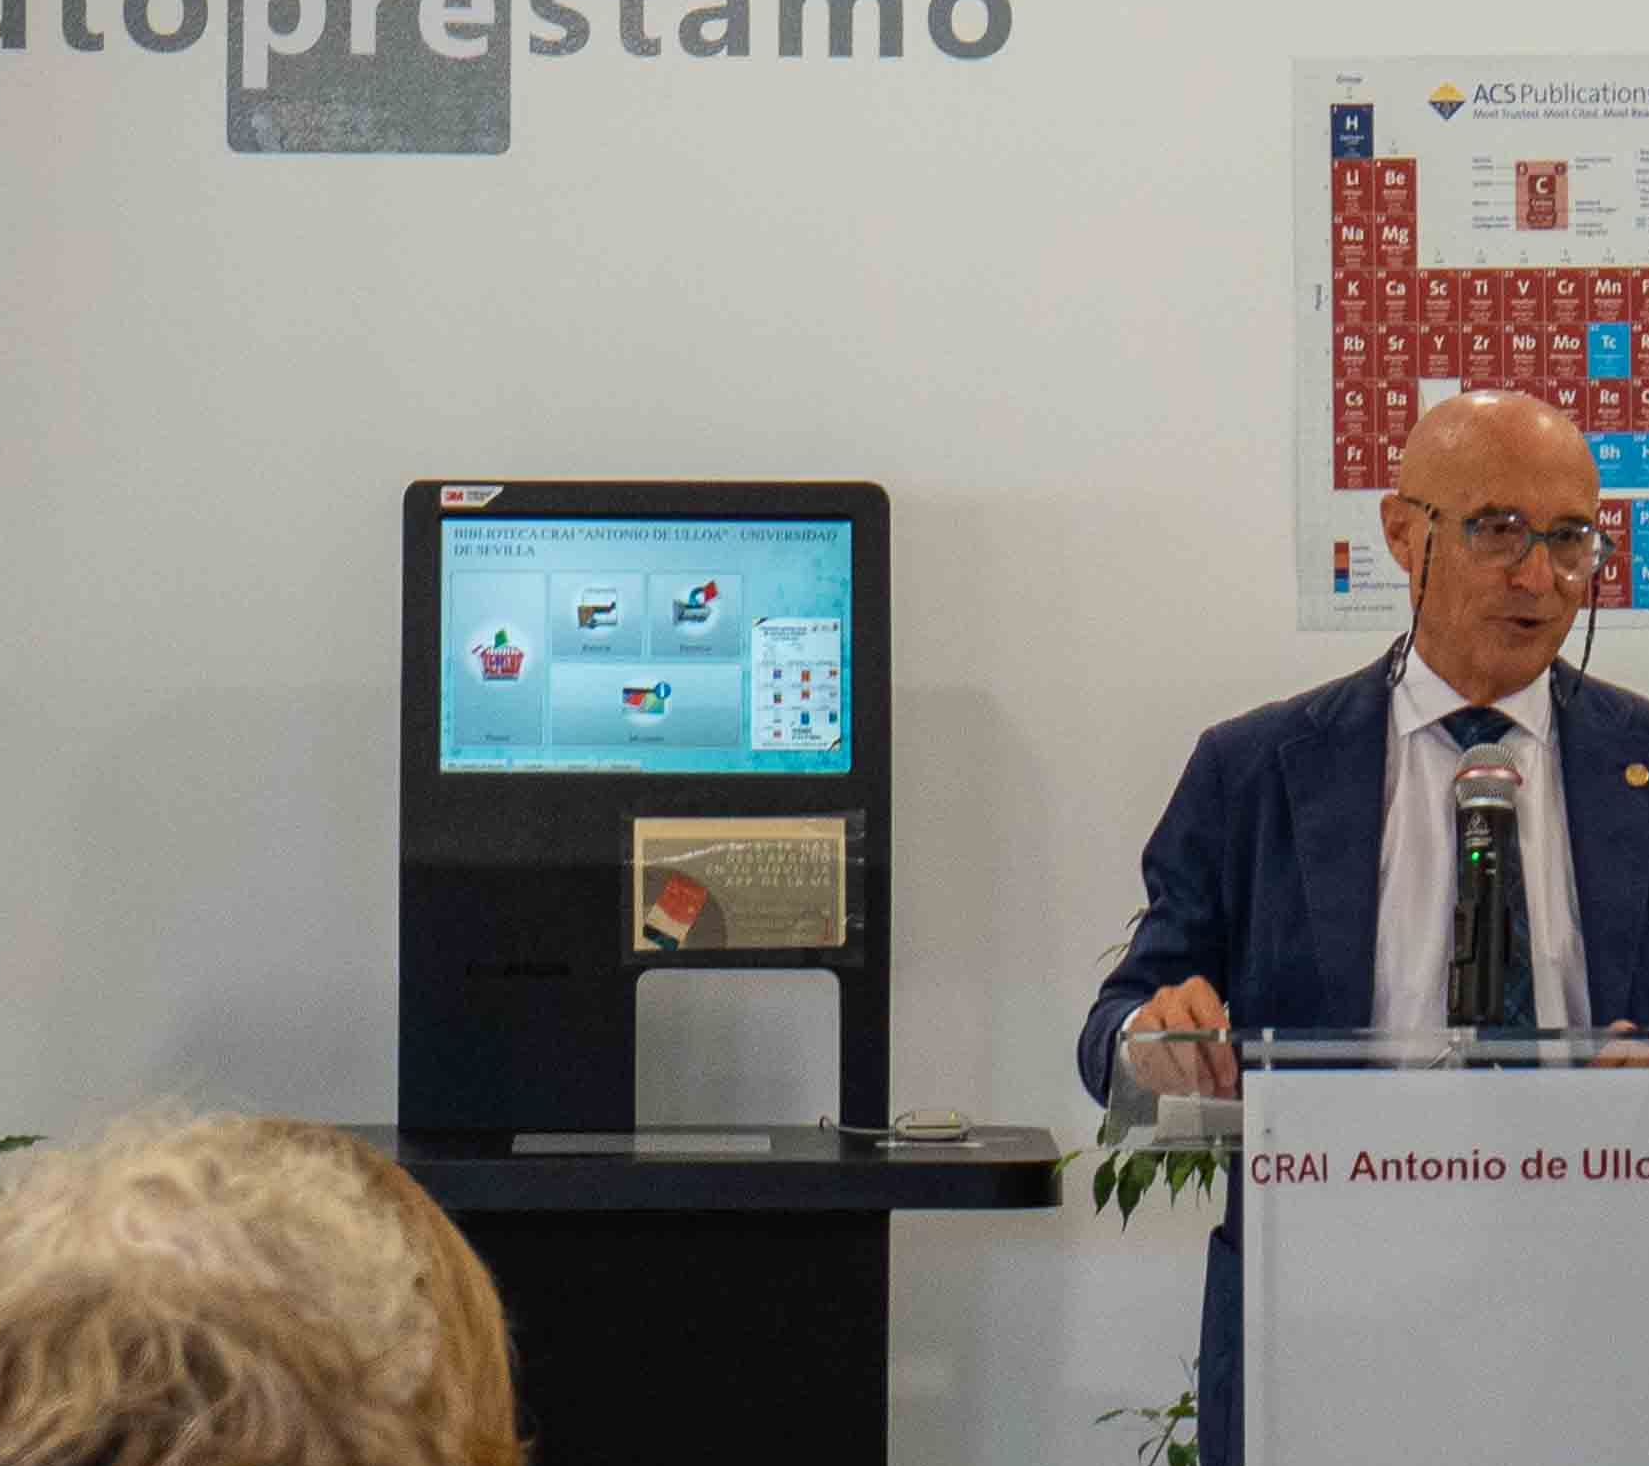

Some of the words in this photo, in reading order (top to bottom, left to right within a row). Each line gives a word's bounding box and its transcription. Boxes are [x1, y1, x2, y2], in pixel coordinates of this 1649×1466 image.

[1473, 83, 1517, 105] ACS
[1345, 115, 1359, 131] H
[1345, 169, 1359, 186] Li
[1384, 169, 1406, 186] Be
[1341, 225, 1364, 241] Na
[1382, 225, 1409, 245] Mg
[1347, 280, 1359, 296] K
[1385, 280, 1406, 296] Ca
[1429, 280, 1448, 296] Sc
[1474, 278, 1488, 296] Ti
[1517, 279, 1530, 296] V
[1557, 279, 1575, 296] Cr
[1595, 278, 1622, 295] Mn
[1343, 334, 1365, 352] Rb
[1387, 334, 1405, 352] Sr
[1433, 334, 1445, 351] Y
[1473, 334, 1490, 351] Zr
[1512, 334, 1537, 351] Nb
[1553, 334, 1581, 350] Mo
[1600, 334, 1618, 350] Tc
[1251, 1152, 1329, 1185] CRAI
[1349, 1148, 1507, 1182] Antonio
[1520, 1149, 1568, 1181] de
